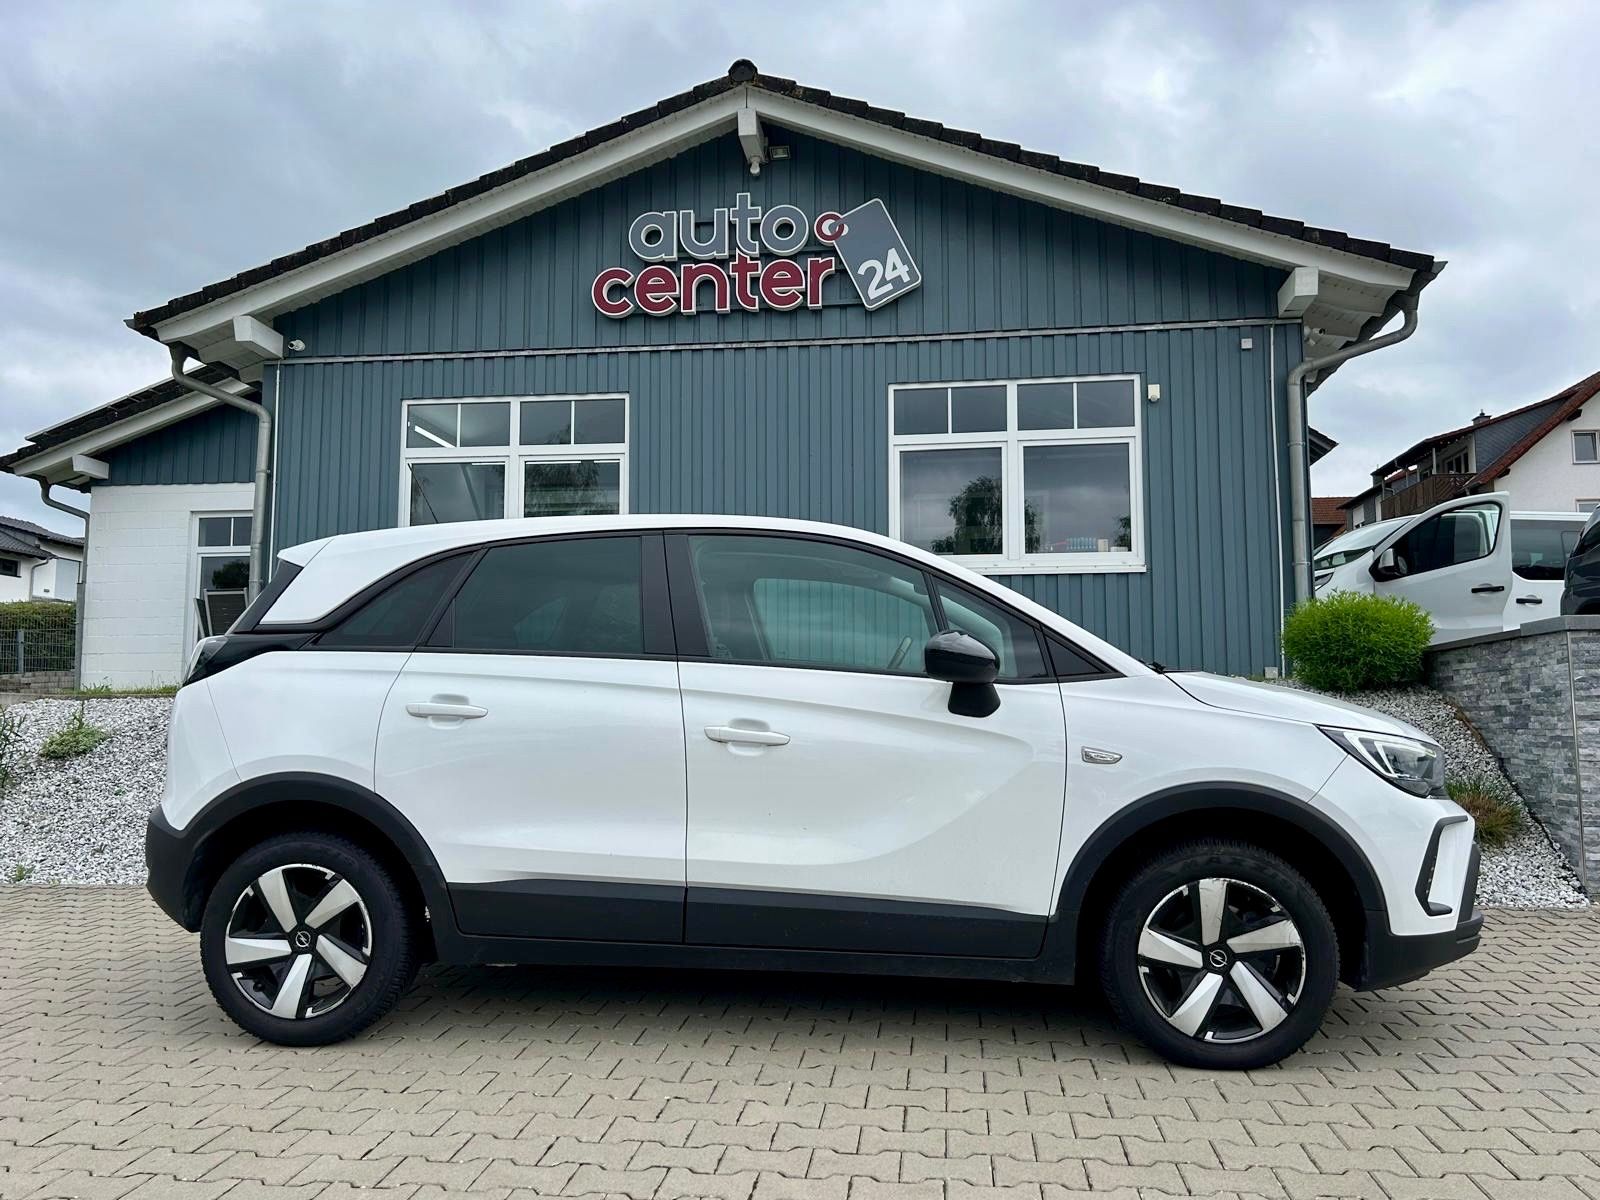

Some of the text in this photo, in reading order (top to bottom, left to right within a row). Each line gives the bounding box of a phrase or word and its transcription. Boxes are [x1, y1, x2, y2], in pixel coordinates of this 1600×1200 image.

[629, 193, 809, 261] auto
[592, 248, 835, 317] center
[858, 248, 909, 299] 24
